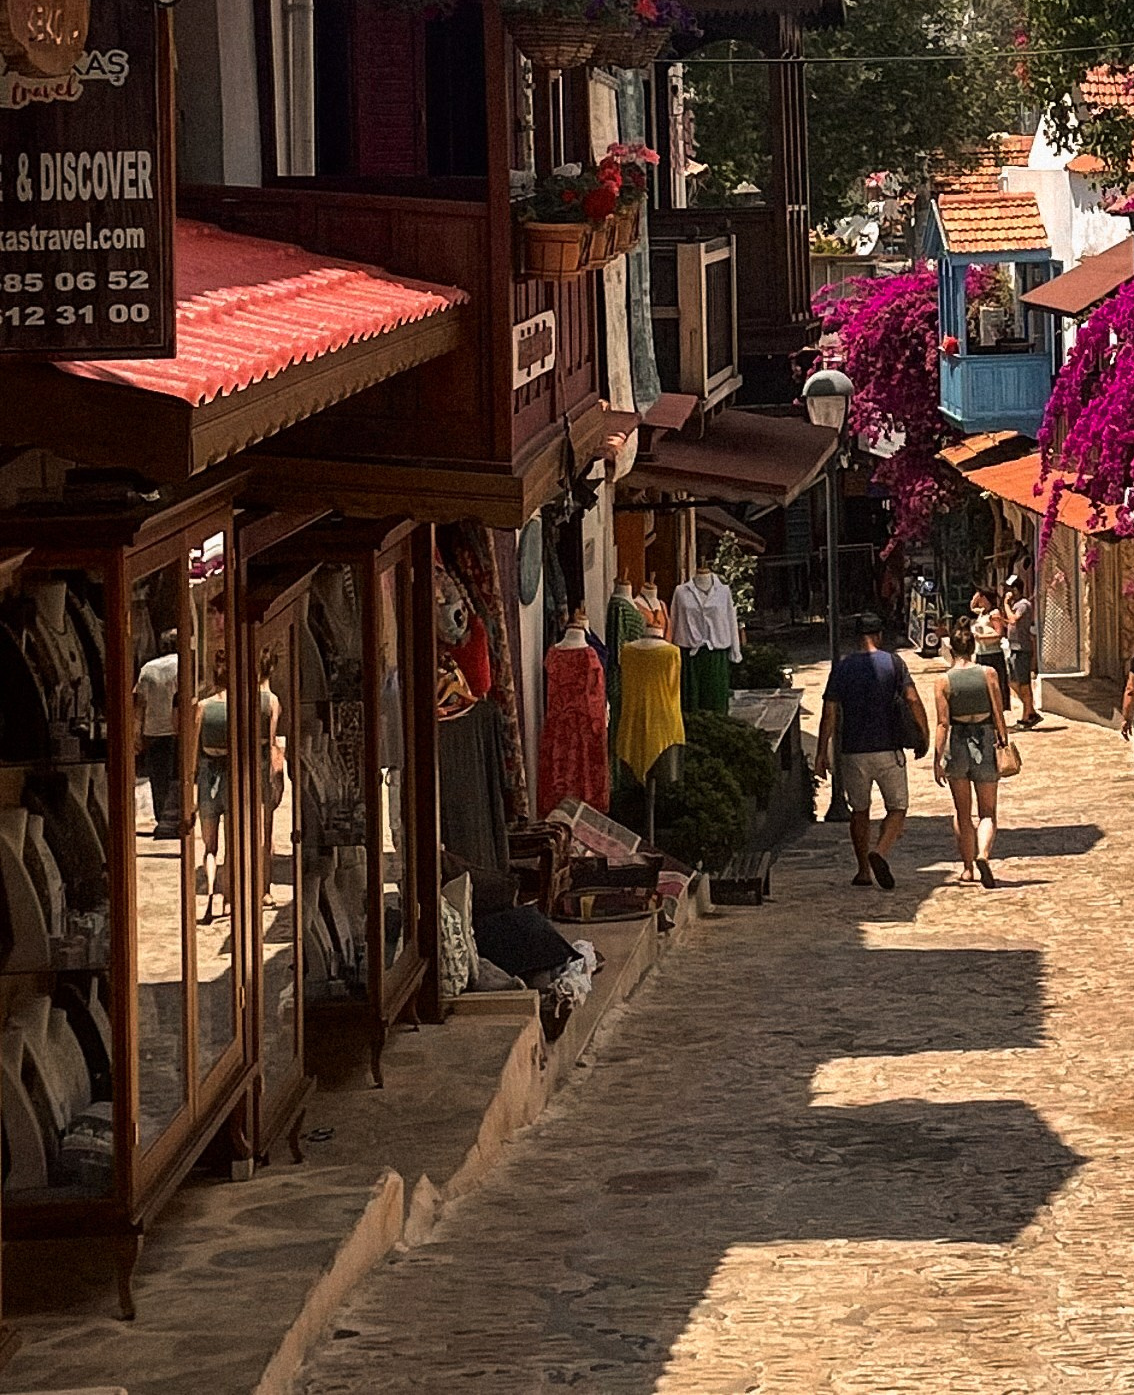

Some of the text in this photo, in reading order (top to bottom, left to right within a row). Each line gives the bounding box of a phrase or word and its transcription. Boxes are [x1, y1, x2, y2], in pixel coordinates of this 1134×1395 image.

[12, 73, 78, 105] travel
[17, 153, 32, 201] &
[41, 151, 153, 201] DISCOVER
[0, 270, 149, 292] 85 06 52
[0, 304, 149, 326] 12 31 00
